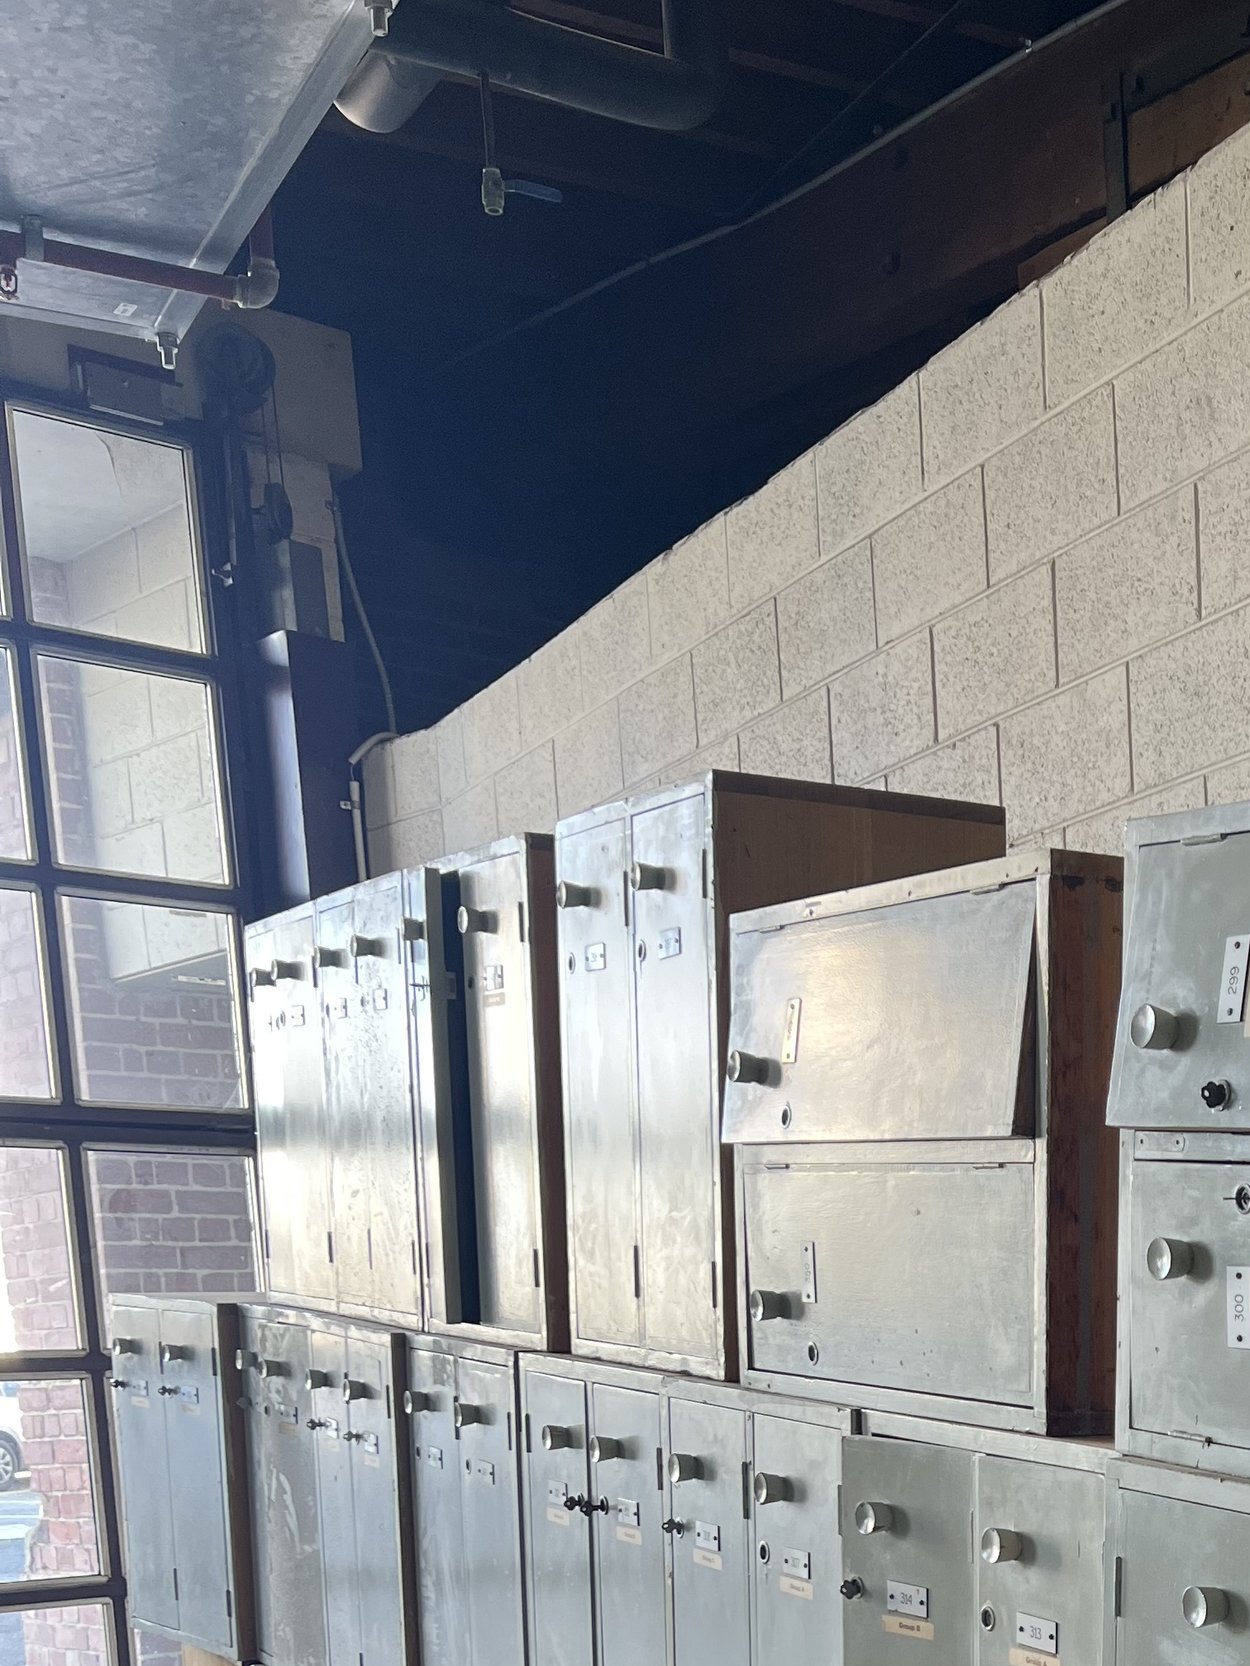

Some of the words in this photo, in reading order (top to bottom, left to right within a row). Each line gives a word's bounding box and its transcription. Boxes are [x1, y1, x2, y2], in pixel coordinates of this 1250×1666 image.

[1228, 966, 1240, 995] 299
[1234, 1294, 1244, 1322] 300
[901, 1592, 912, 1605] 314
[898, 1622, 914, 1632] Group
[1030, 1625, 1042, 1640] 313
